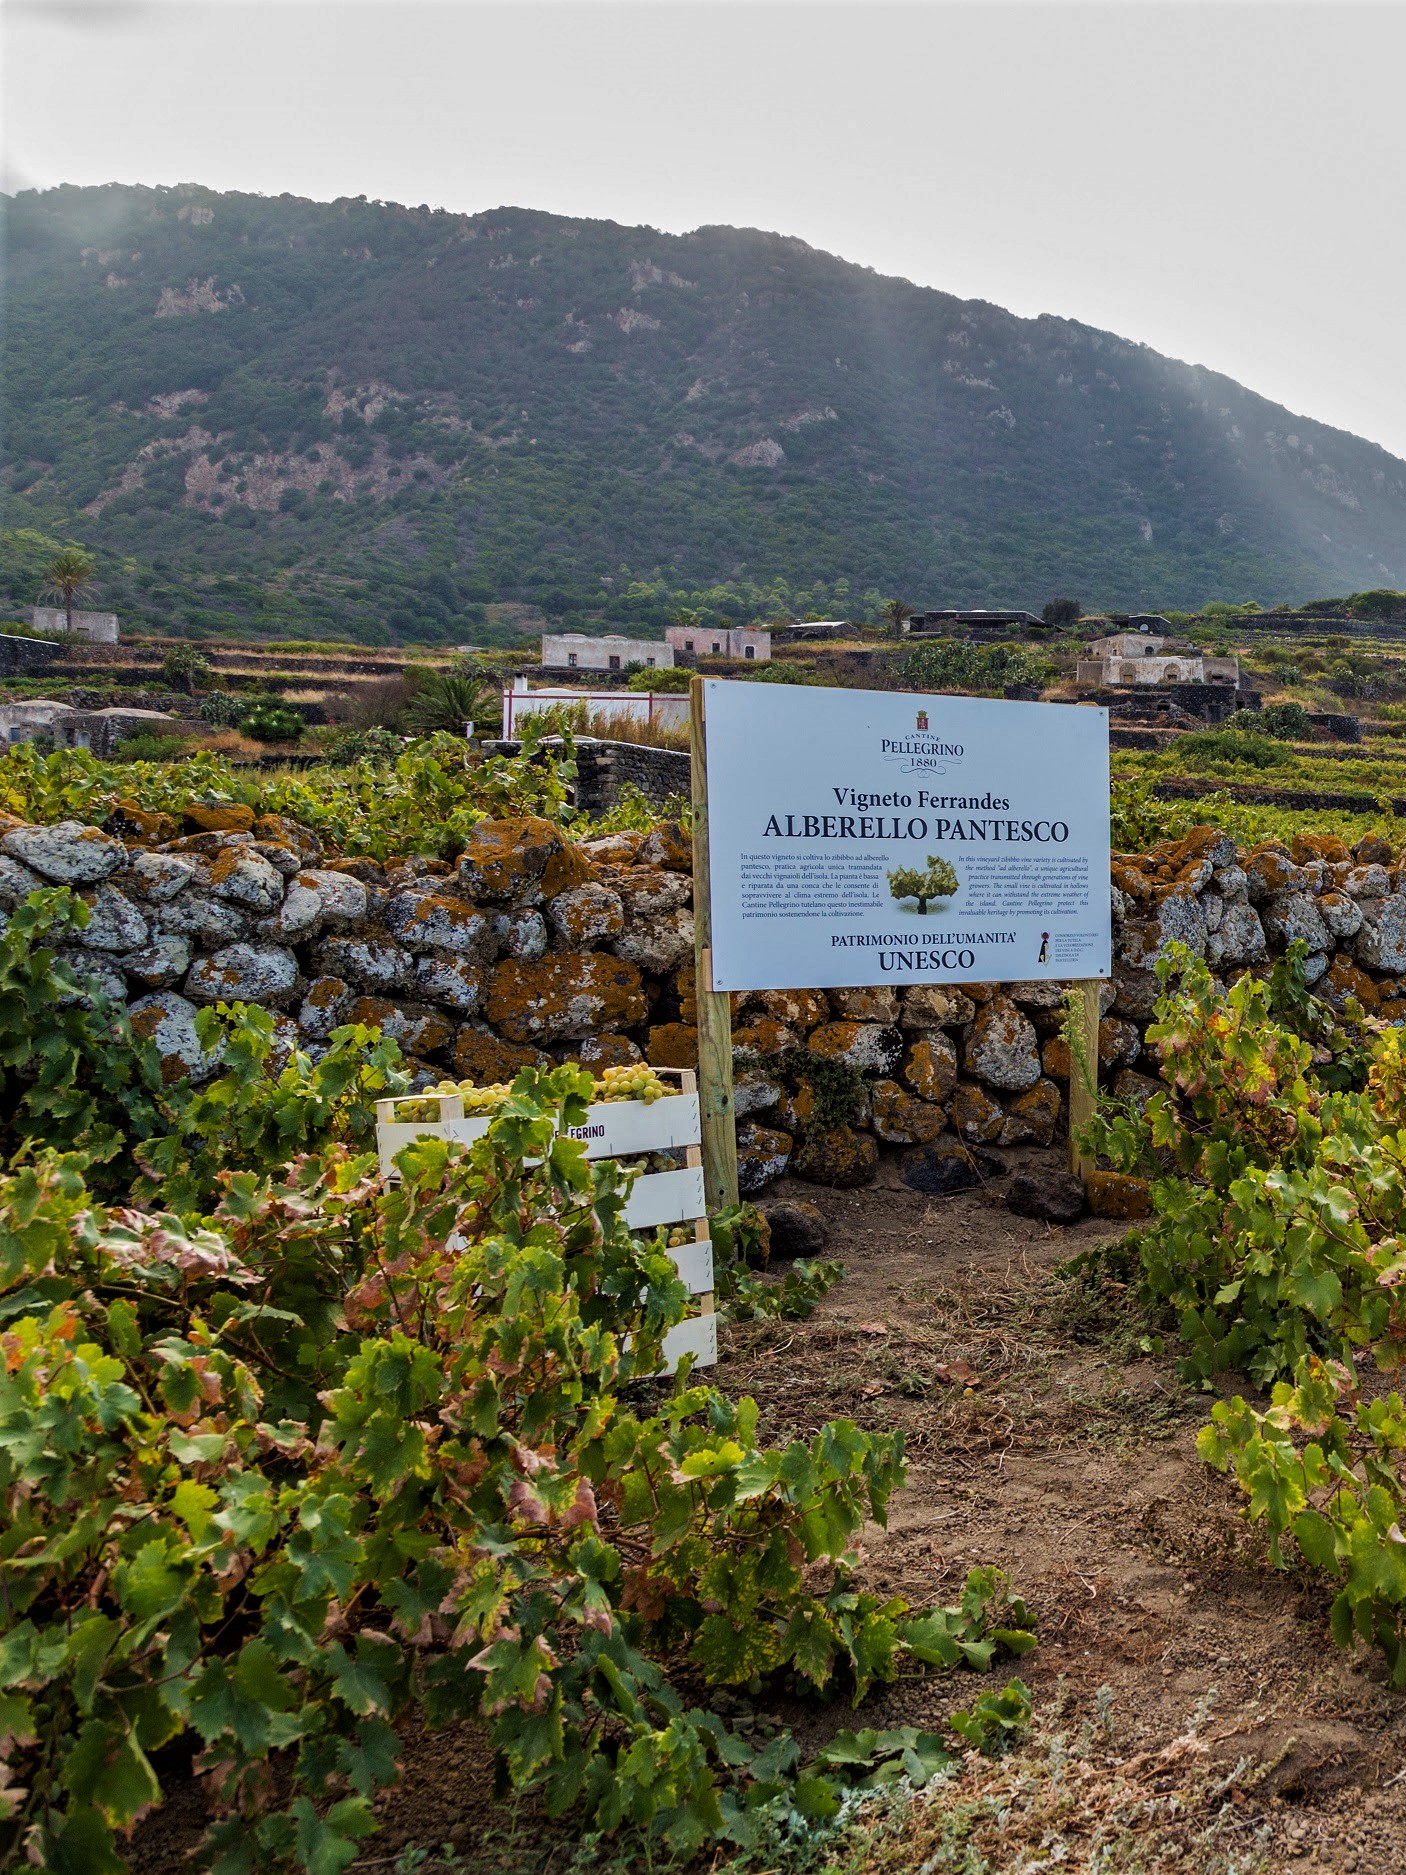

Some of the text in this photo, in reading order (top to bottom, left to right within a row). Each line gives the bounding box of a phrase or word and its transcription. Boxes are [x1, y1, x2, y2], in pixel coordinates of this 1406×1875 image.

[905, 734, 940, 742] CANTINE
[881, 739, 964, 756] PELLEGRINO
[911, 758, 937, 767] 1880
[832, 788, 1010, 812] Vigneto Ferrandes
[762, 814, 1069, 842] ALBERELLO PANTESCO
[977, 856, 1000, 864] vineyard
[800, 863, 824, 872] agricola
[774, 872, 800, 881] vignaioli
[768, 901, 800, 909] Pellegrino
[831, 934, 918, 946] PATRIMONIO
[878, 950, 975, 970] UNESCO
